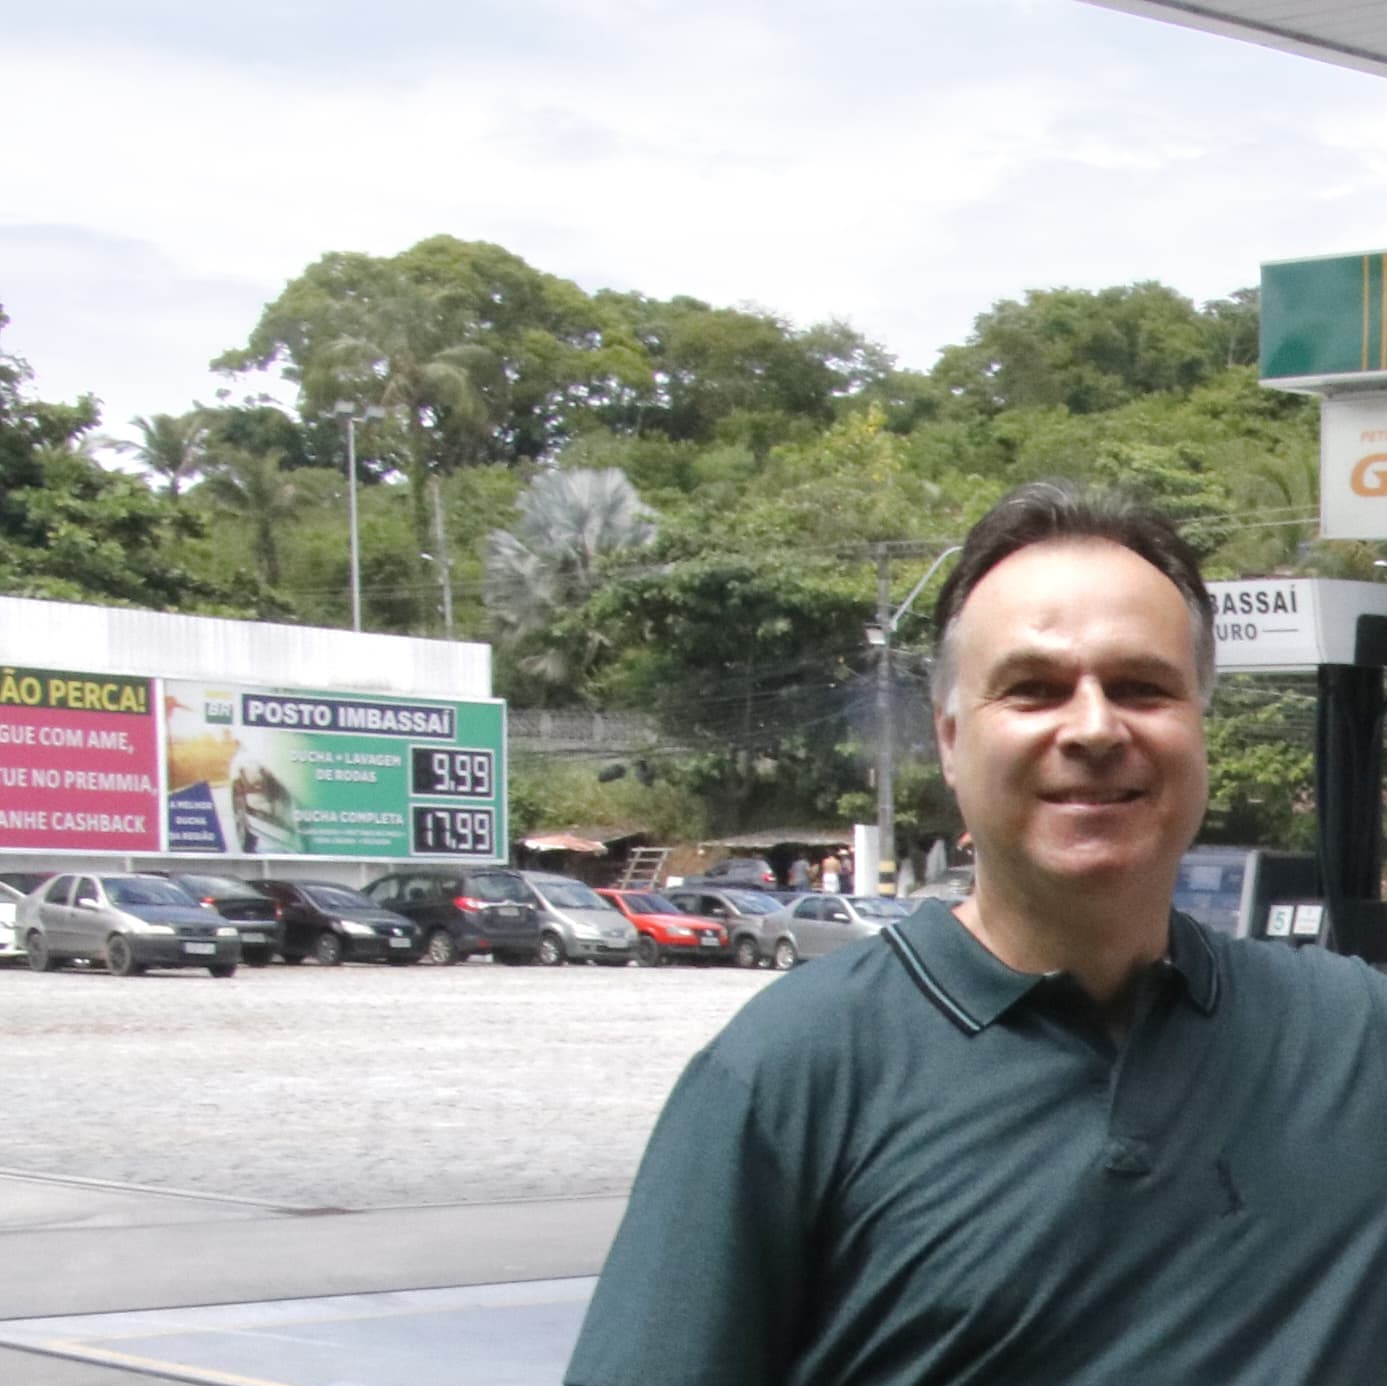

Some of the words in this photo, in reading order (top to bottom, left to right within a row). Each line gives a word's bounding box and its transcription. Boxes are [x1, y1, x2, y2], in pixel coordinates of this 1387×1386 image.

[48, 678, 146, 713] PERCA!
[249, 701, 332, 727] POSTO
[338, 707, 450, 734] IMBASSAÍ
[39, 727, 83, 748] COM
[87, 731, 135, 754] AME,
[345, 752, 402, 766] LAVAGEM
[32, 769, 61, 788] NO
[64, 770, 159, 796] PREMMIA,
[316, 770, 334, 781] DE
[432, 753, 490, 793] 9.99
[52, 811, 147, 834] CASHBACK
